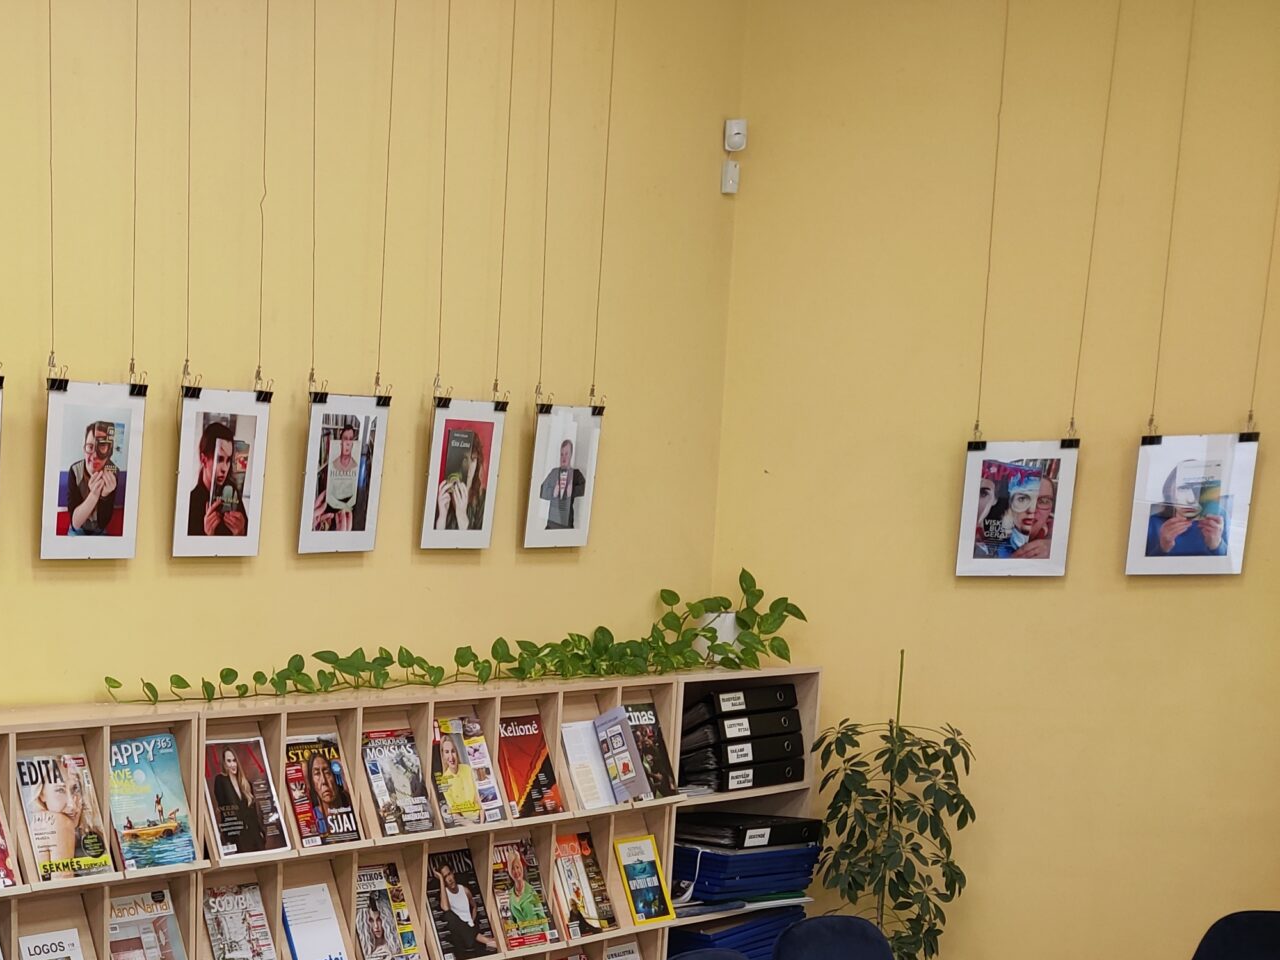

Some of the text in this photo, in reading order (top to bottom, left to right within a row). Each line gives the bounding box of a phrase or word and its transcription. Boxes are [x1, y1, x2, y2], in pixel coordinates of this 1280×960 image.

[500, 720, 539, 738] Kelionė
[17, 759, 64, 787] EDITA
[27, 941, 65, 956] LOGOS
